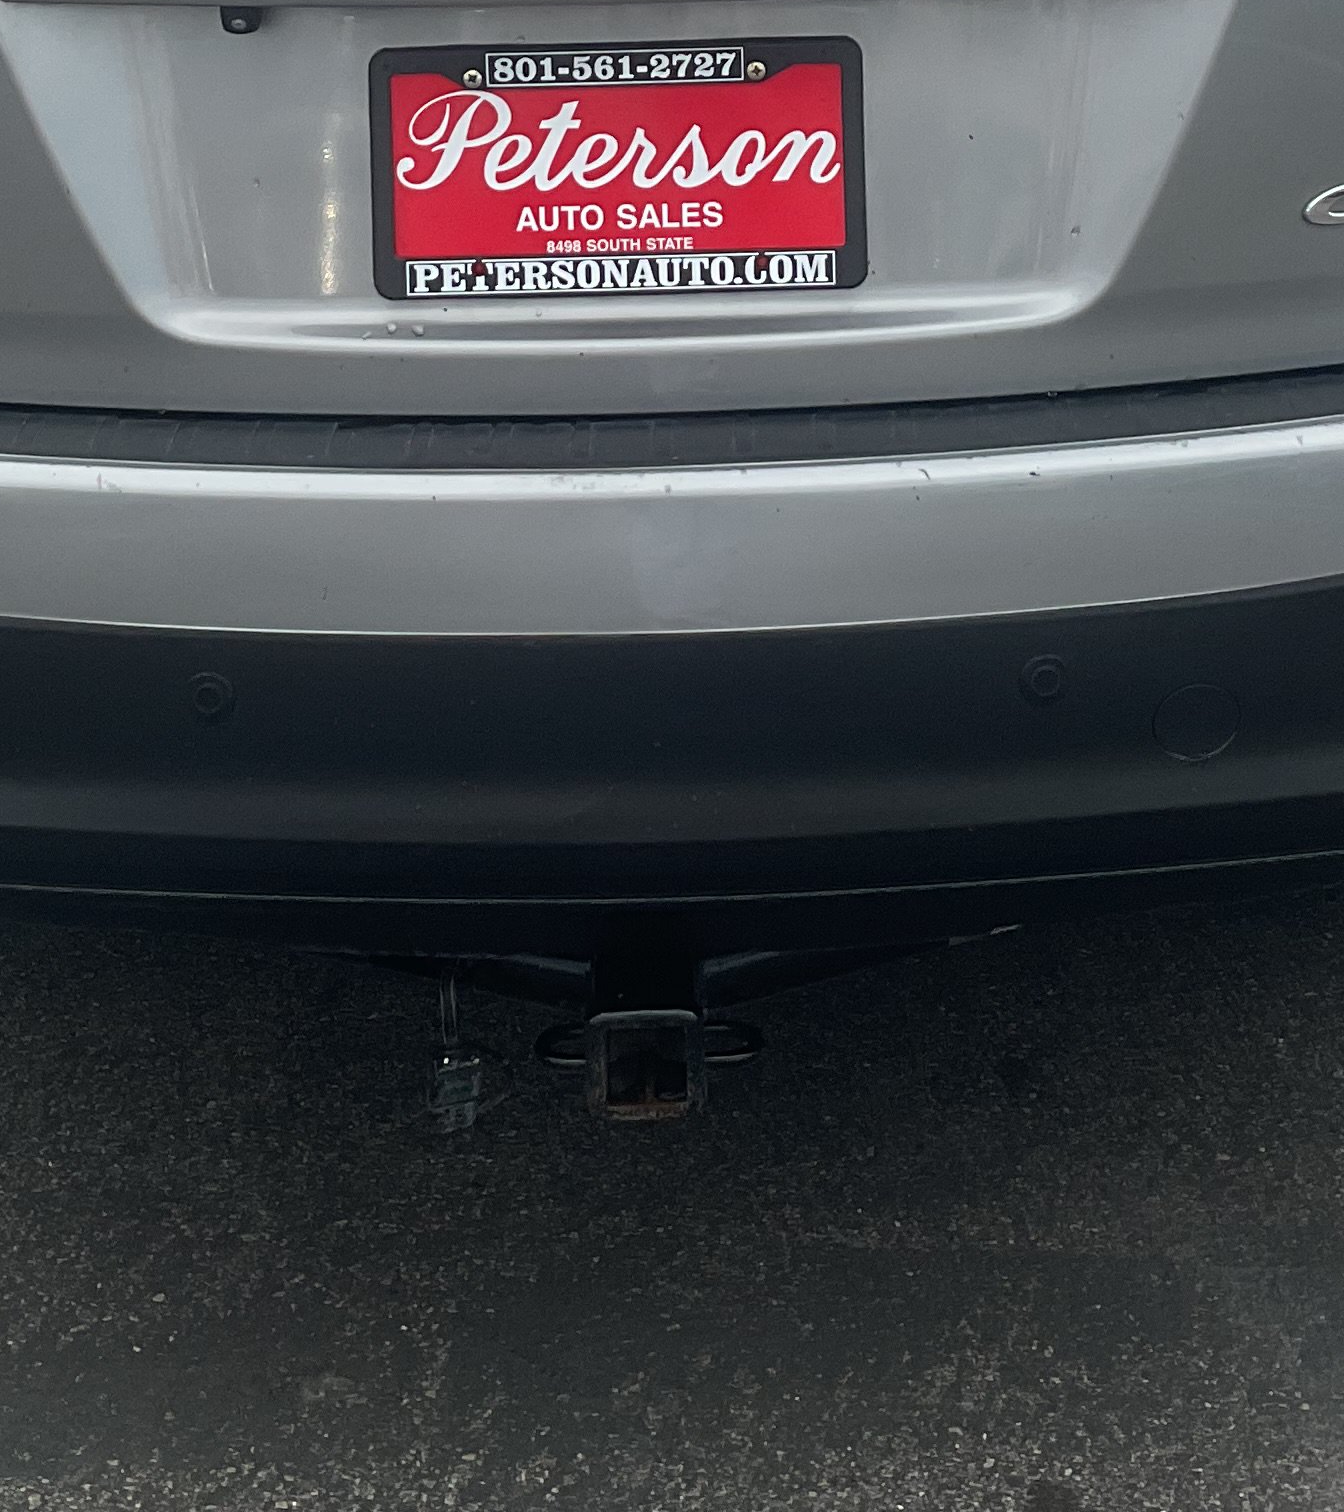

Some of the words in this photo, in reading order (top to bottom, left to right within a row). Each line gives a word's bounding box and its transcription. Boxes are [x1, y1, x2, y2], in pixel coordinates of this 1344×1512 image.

[492, 51, 737, 84] 801-561-2727
[396, 89, 841, 191] Peterson
[516, 204, 605, 232] AUTO
[616, 202, 724, 230] SALES
[546, 240, 582, 254] 8498
[586, 238, 642, 253] SOUTH
[645, 236, 694, 251] STATE
[413, 253, 829, 293] PETERSONAUTO.COM
